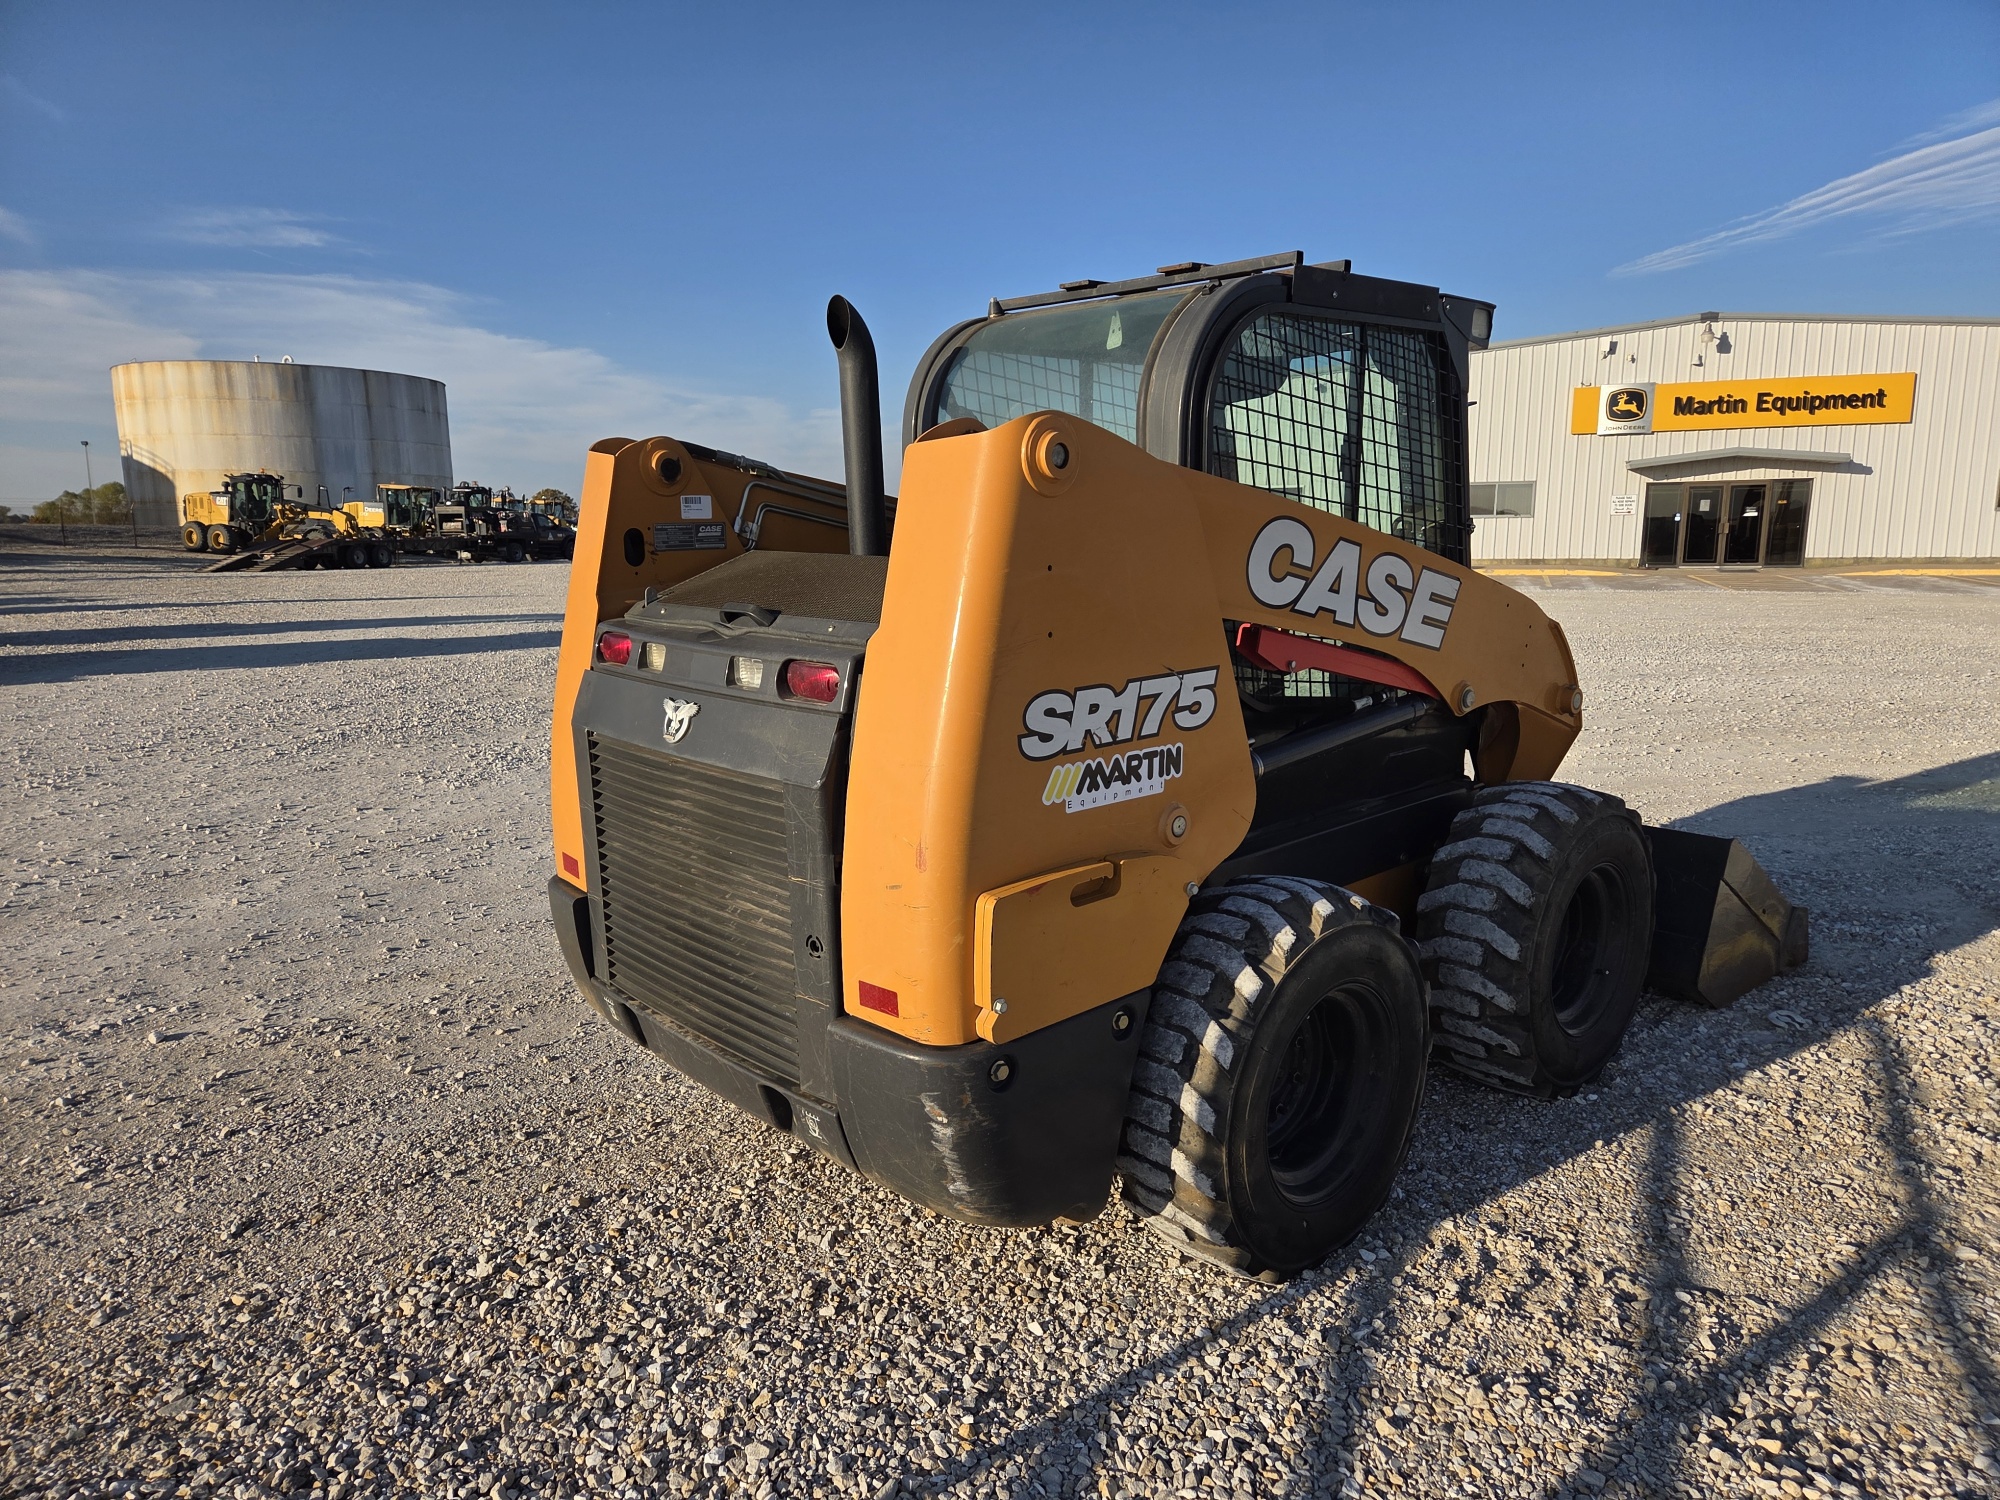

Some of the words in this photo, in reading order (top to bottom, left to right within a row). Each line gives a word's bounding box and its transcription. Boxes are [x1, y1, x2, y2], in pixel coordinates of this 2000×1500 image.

[1673, 394, 1747, 416] Martin
[1756, 388, 1887, 416] Equipment
[699, 525, 723, 533] CASE
[1247, 515, 1462, 651] CASE
[1018, 665, 1220, 761] SR175
[1076, 745, 1182, 795] MARTIN
[1067, 781, 1164, 809] Equipment
